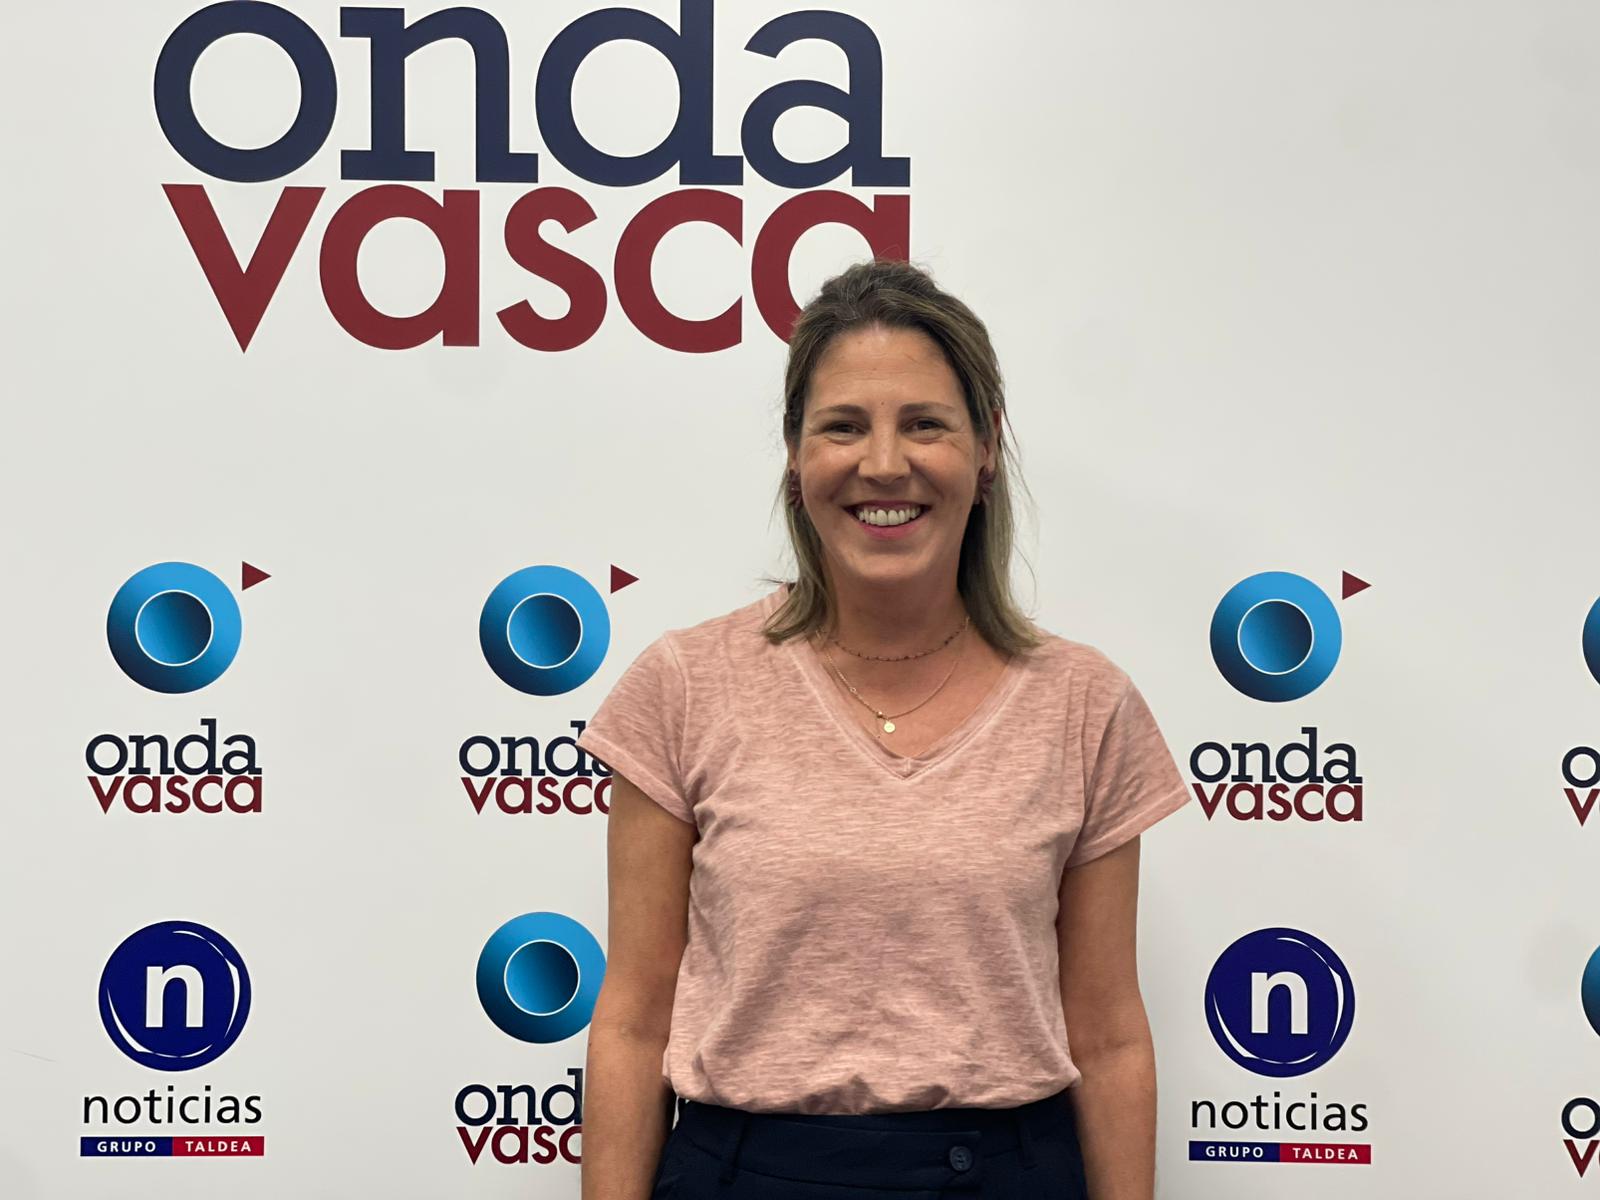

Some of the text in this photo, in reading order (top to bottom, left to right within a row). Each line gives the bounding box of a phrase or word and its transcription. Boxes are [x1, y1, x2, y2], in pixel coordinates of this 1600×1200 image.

[153, 0, 911, 189] onda
[161, 184, 911, 353] vasca
[86, 718, 262, 776] onda
[459, 720, 613, 777] ond
[1190, 727, 1363, 784] onda
[87, 775, 262, 814] vasca
[1192, 783, 1363, 822] vasca
[83, 1085, 262, 1124] noticias
[455, 1068, 583, 1126] ond
[1191, 1091, 1369, 1132] noticias
[97, 1141, 251, 1152] GRUPO TALDEA
[456, 1125, 582, 1165] vasc
[1205, 1146, 1358, 1160] GRUPO TALDEA
